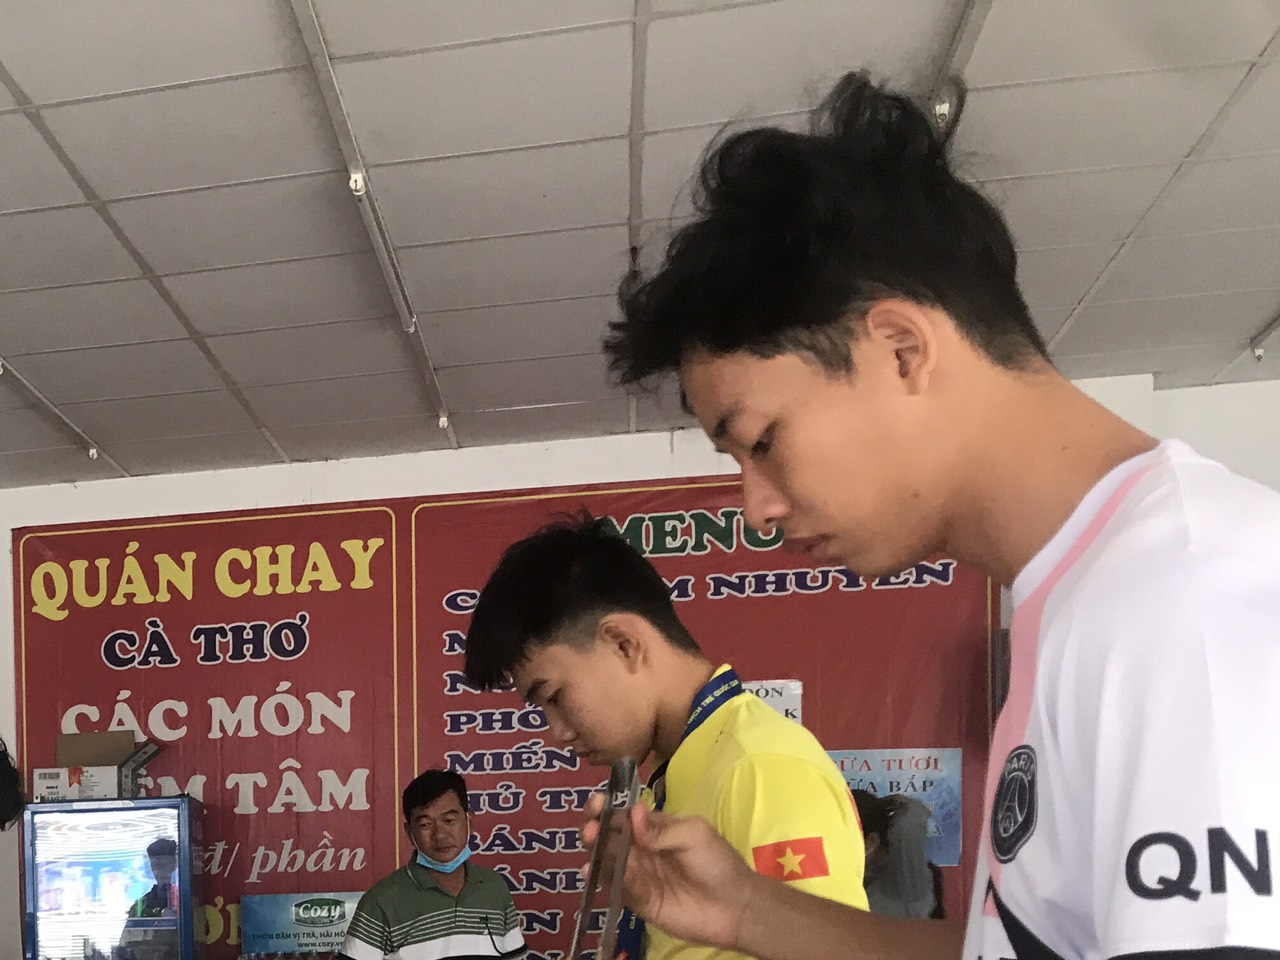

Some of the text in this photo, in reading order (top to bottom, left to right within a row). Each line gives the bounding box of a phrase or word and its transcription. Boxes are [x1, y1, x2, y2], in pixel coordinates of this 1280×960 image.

[30, 537, 384, 621] QUÁN CHAY
[101, 611, 310, 670] CÀ THƠ
[61, 681, 356, 742] CÁC MÓN
[444, 738, 580, 774] MIẾN
[881, 755, 940, 772] TƯƠI
[225, 758, 371, 815] TÂM
[245, 830, 367, 884] phần
[1125, 826, 1273, 902] QN
[299, 903, 340, 920] Cozy
